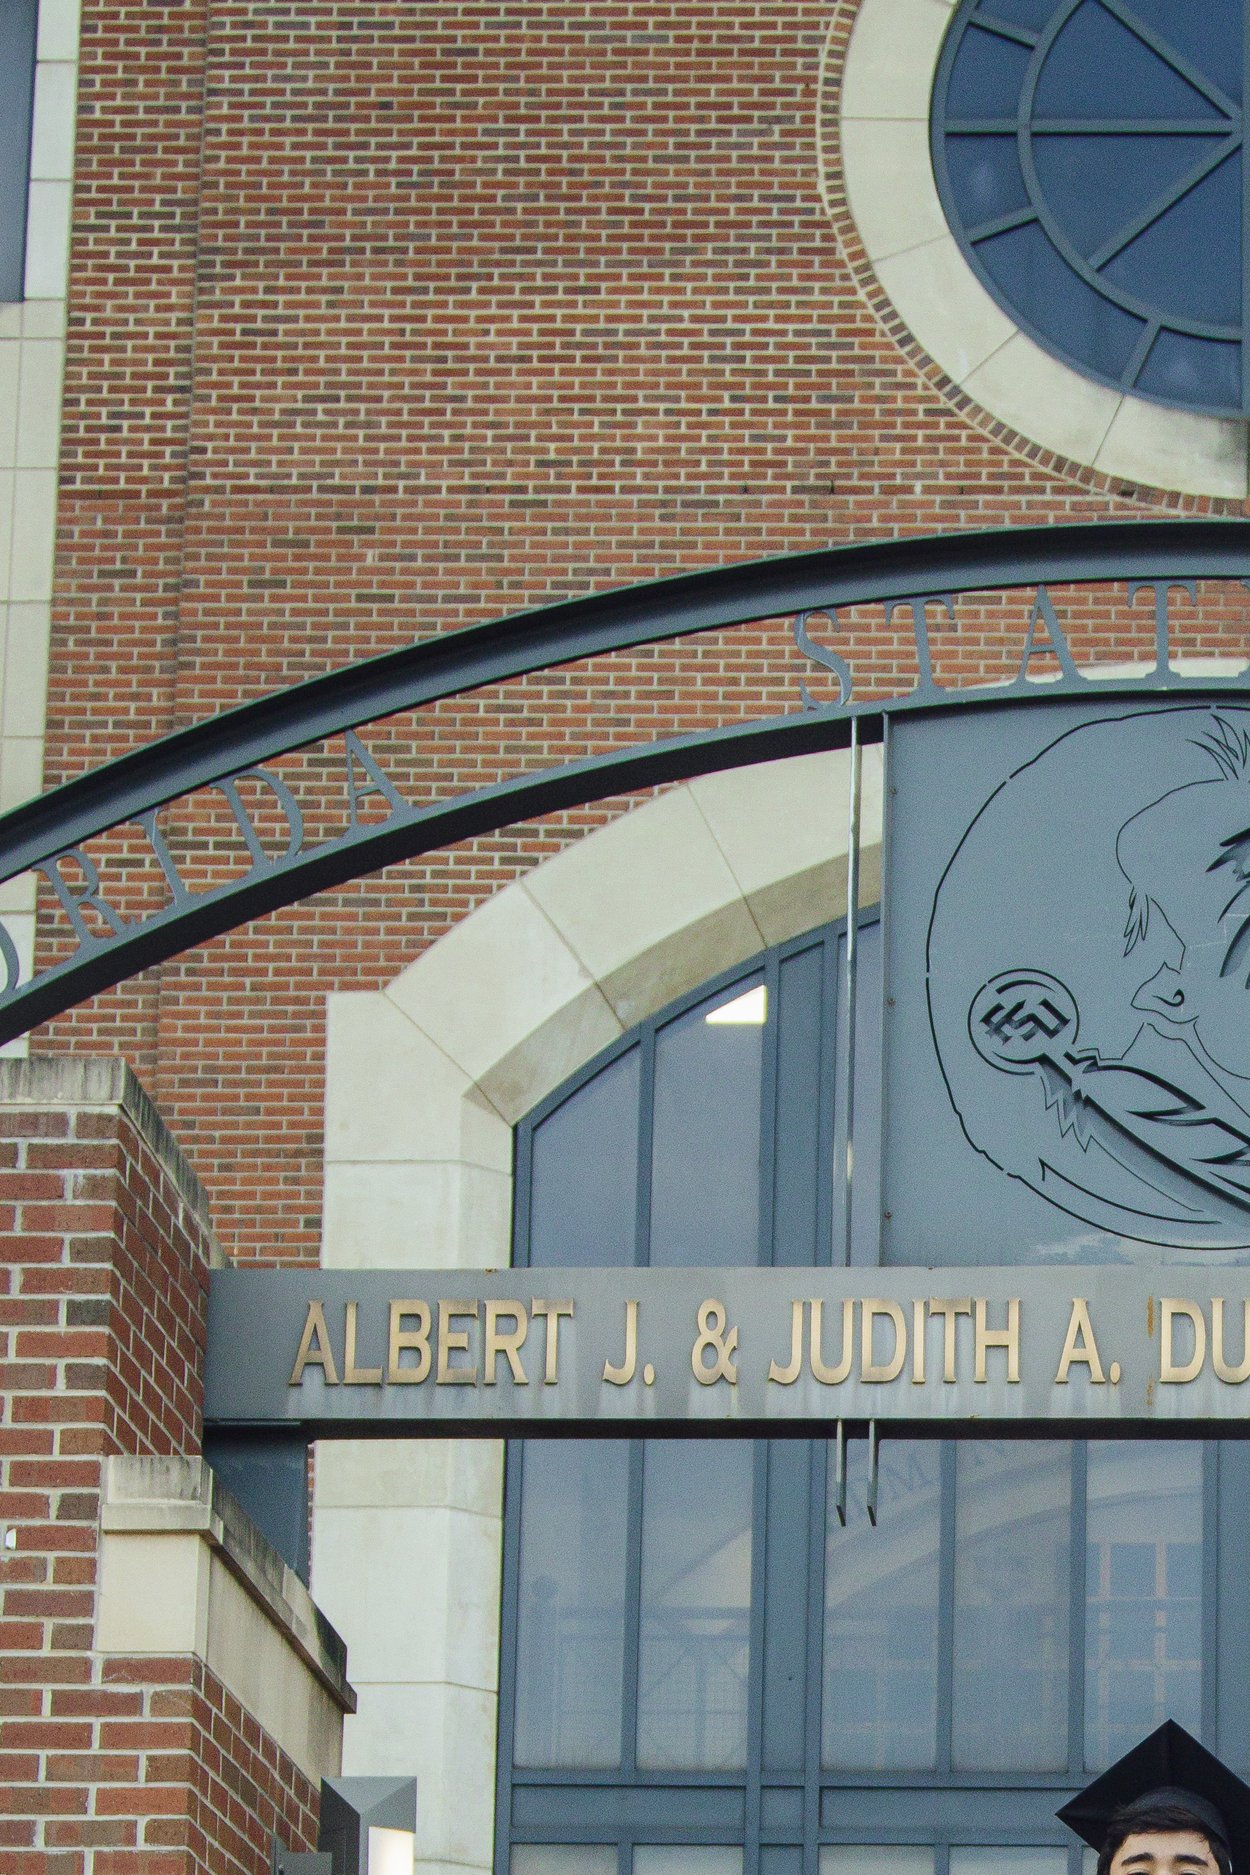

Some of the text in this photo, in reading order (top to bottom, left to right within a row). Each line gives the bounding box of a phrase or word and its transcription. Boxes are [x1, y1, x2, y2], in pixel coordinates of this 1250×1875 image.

[980, 998, 1071, 1046] FSU
[288, 1299, 574, 1386] ALBERT
[603, 1299, 657, 1386] J.
[692, 1299, 738, 1385] &
[769, 1299, 1021, 1385] JUDITH
[1056, 1298, 1121, 1385] A.
